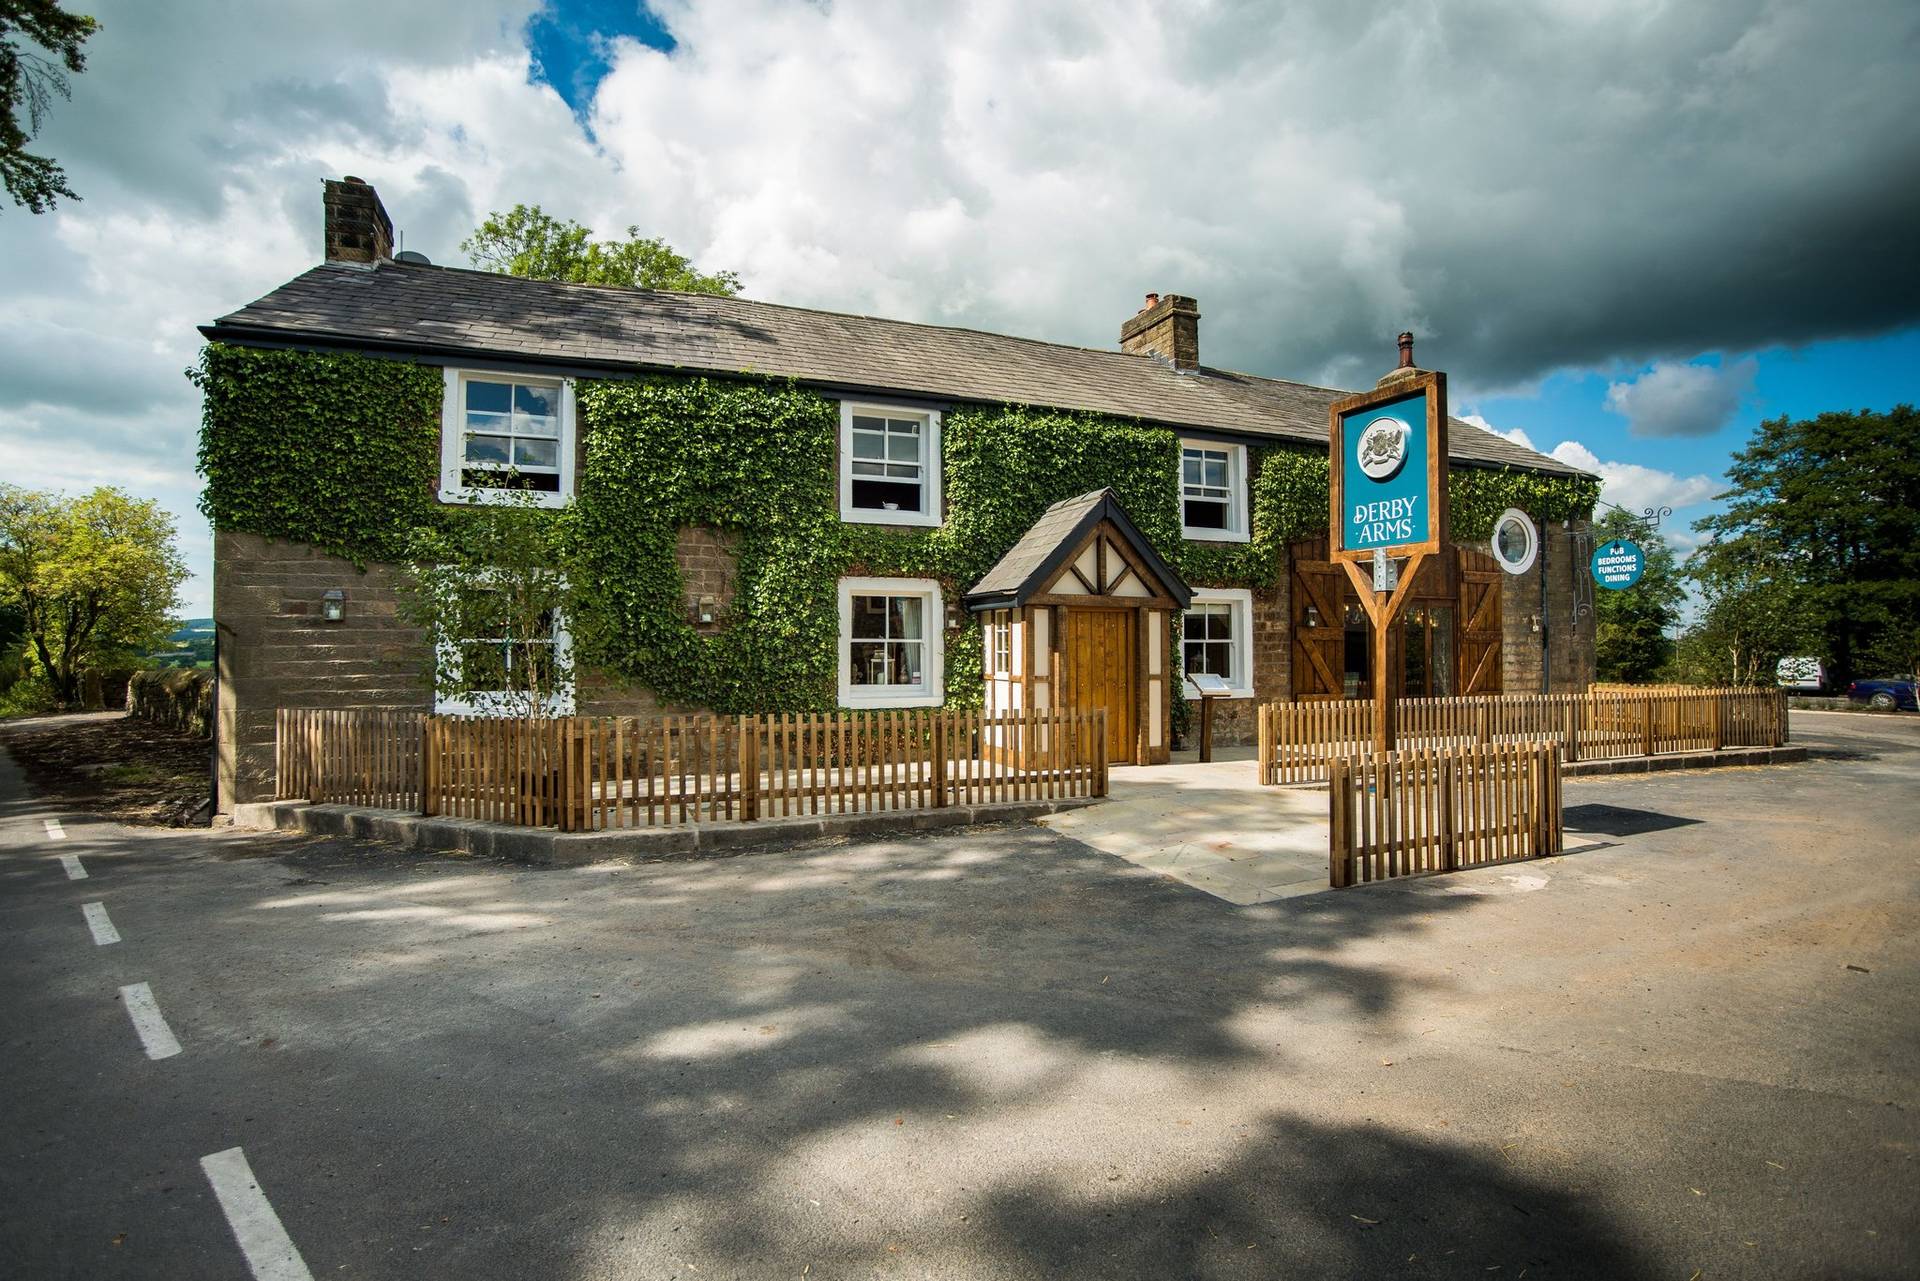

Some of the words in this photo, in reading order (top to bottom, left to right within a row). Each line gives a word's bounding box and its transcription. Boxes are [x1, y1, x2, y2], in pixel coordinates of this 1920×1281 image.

[1353, 496, 1418, 525] DERBY
[1357, 518, 1413, 544] ARMS
[1610, 547, 1625, 555] PUB
[1598, 555, 1637, 566] BEDROOMS
[1598, 564, 1637, 574] FUNCTIONS
[1605, 574, 1631, 583] DINING
